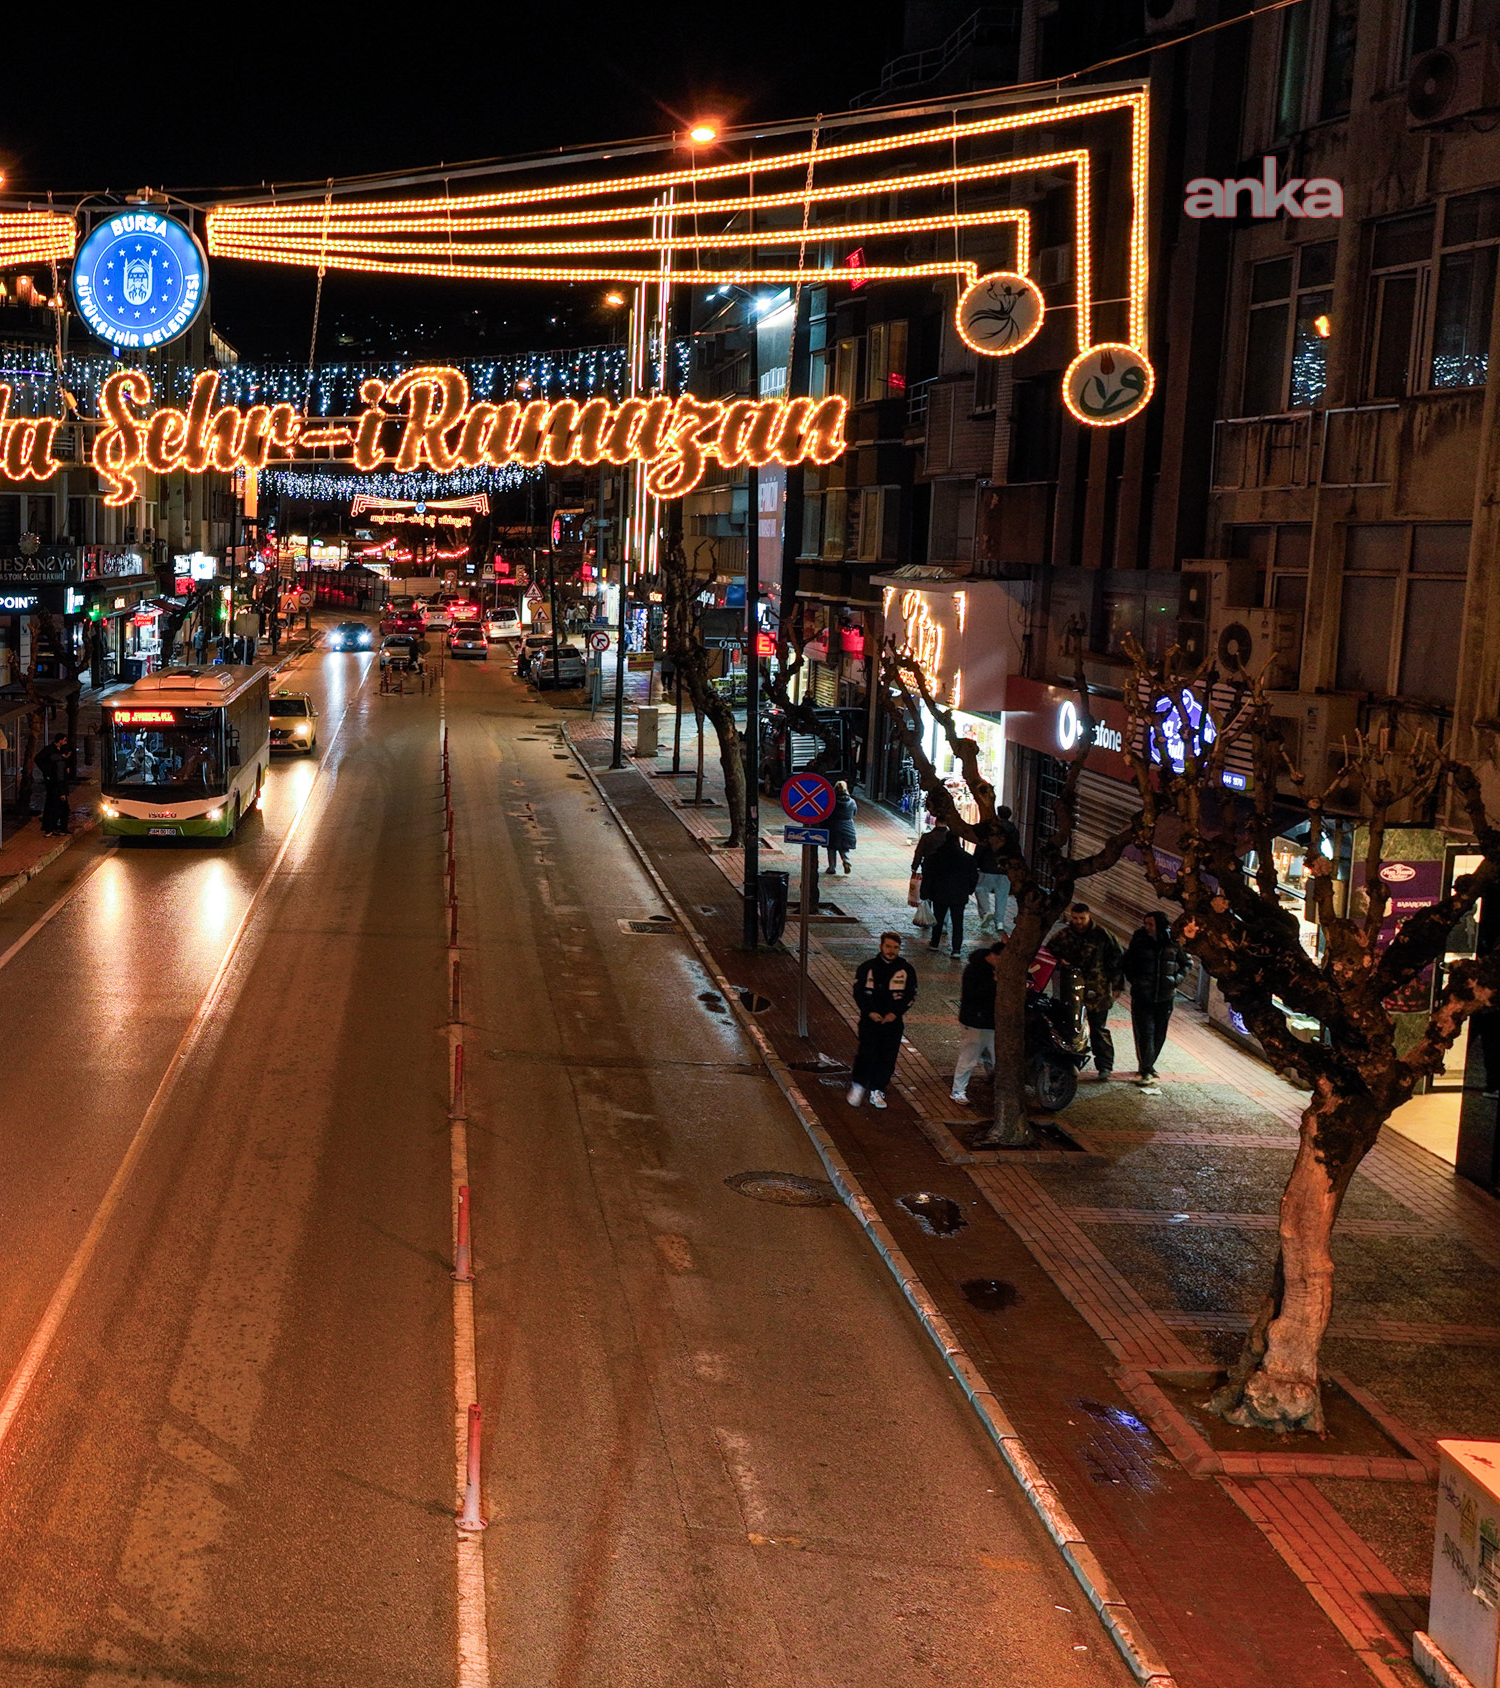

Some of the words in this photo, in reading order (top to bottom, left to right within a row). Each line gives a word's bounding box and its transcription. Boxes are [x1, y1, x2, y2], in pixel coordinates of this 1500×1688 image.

[110, 214, 167, 238] BURSA
[76, 274, 140, 347] BÜYÜKŞEHİR
[143, 273, 200, 347] BELEDİYESİ
[385, 365, 848, 500] Ramazan
